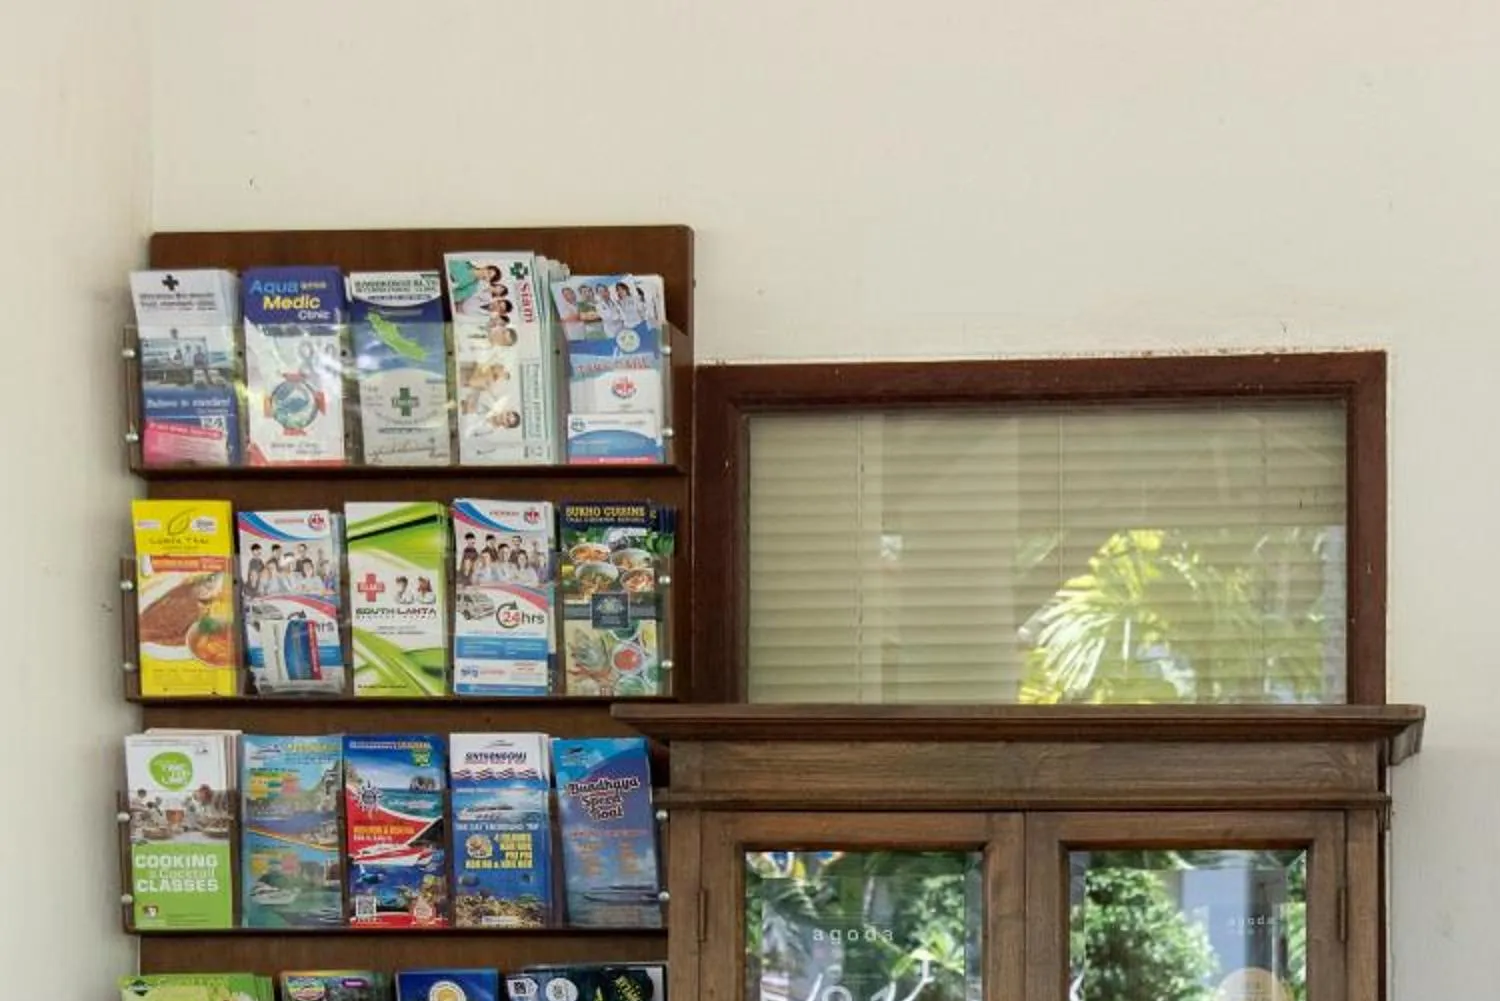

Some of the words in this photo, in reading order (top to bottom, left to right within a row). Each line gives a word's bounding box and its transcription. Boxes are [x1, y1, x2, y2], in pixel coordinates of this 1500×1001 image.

[250, 280, 298, 294] Aqua
[263, 295, 321, 311] Medic
[297, 310, 331, 321] Clinic
[136, 853, 218, 869] COOKING
[136, 879, 219, 893] CLASSES
